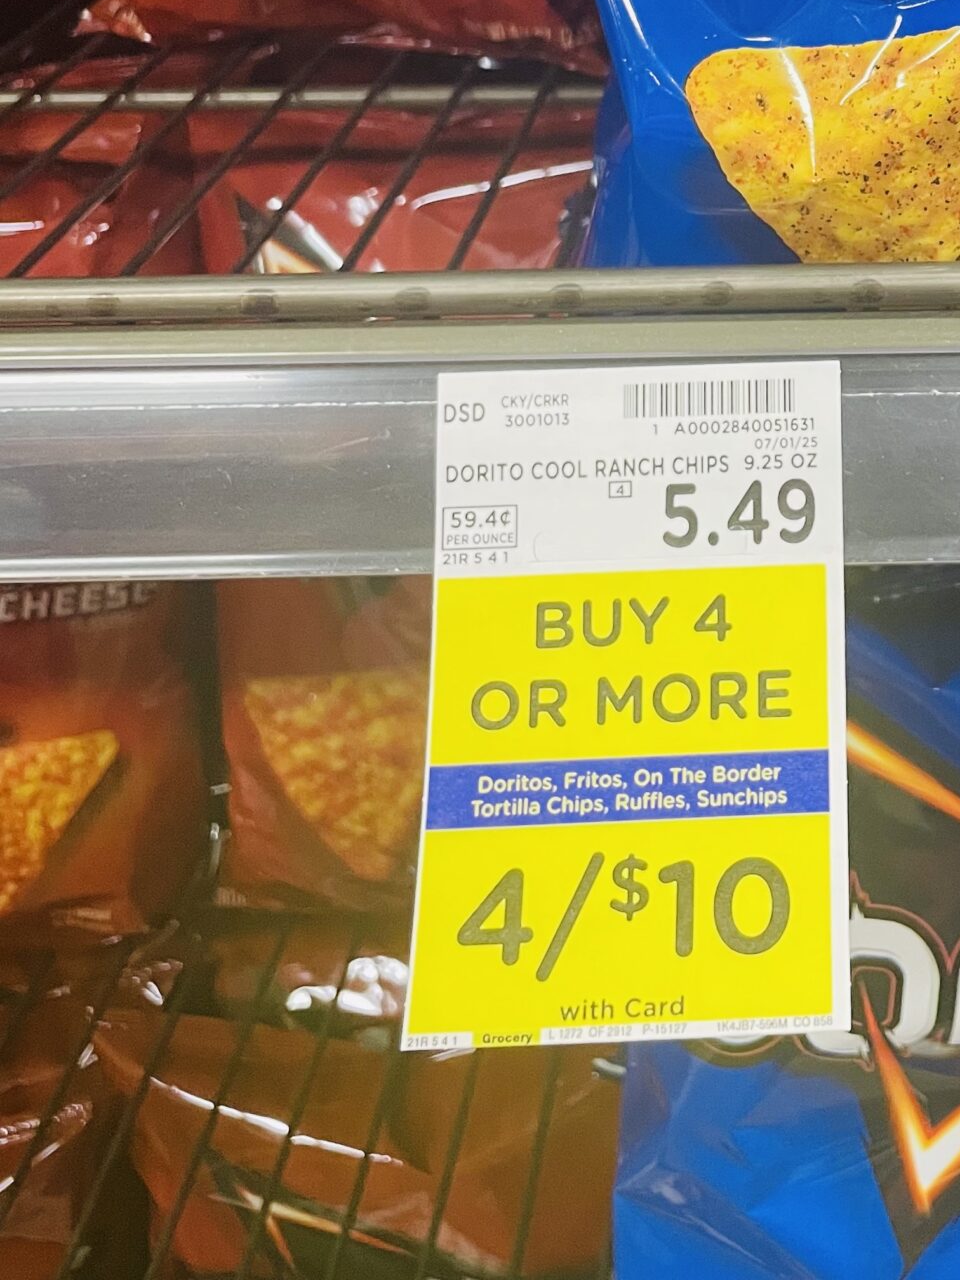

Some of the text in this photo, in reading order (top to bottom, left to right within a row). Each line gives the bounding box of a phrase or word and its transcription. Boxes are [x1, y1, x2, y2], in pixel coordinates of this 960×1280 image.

[501, 394, 569, 409] CKY/CRKR
[444, 403, 485, 423] DSD
[505, 413, 570, 427] 3001013
[674, 417, 815, 435] A0002840051631
[754, 436, 818, 450] 07/01/25
[446, 453, 818, 483] DORITO COOL RANCH CHIPS 9.25 OZ
[450, 510, 511, 529] 59.4¢
[663, 478, 816, 549] 5.49
[446, 532, 514, 545] PER OUNCE
[443, 553, 468, 565] 21R
[535, 593, 732, 649] BUY 4
[470, 669, 792, 730] OR MORE
[477, 763, 782, 794] Doritos, Fritos, On The Border
[471, 787, 788, 818] Tortilla Chips, Ruffles, Sunchips
[560, 996, 686, 1021] with Card
[482, 1033, 533, 1045] Grocery
